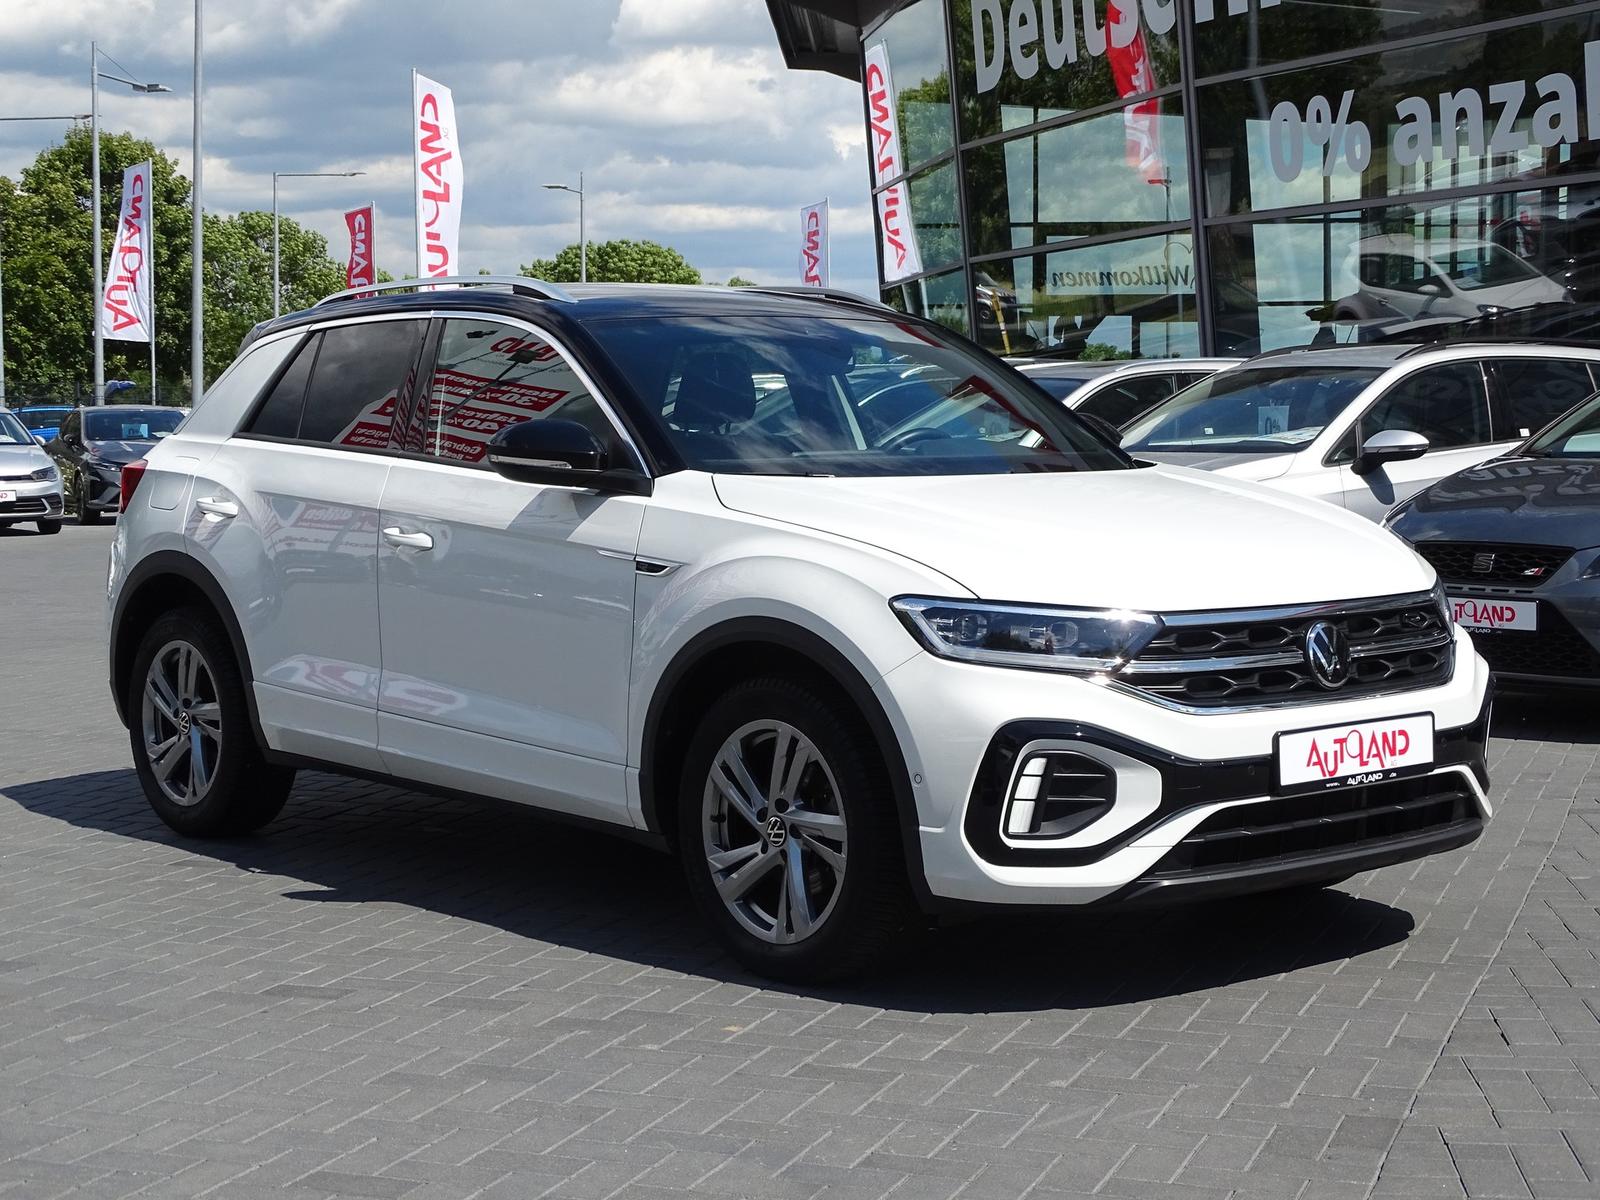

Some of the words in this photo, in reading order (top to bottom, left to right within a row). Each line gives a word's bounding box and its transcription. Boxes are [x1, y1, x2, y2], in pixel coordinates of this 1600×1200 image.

[1269, 89, 1371, 183] 0%
[1306, 729, 1410, 778] AUTOLAND
[1346, 772, 1384, 786] AUTOLAND
